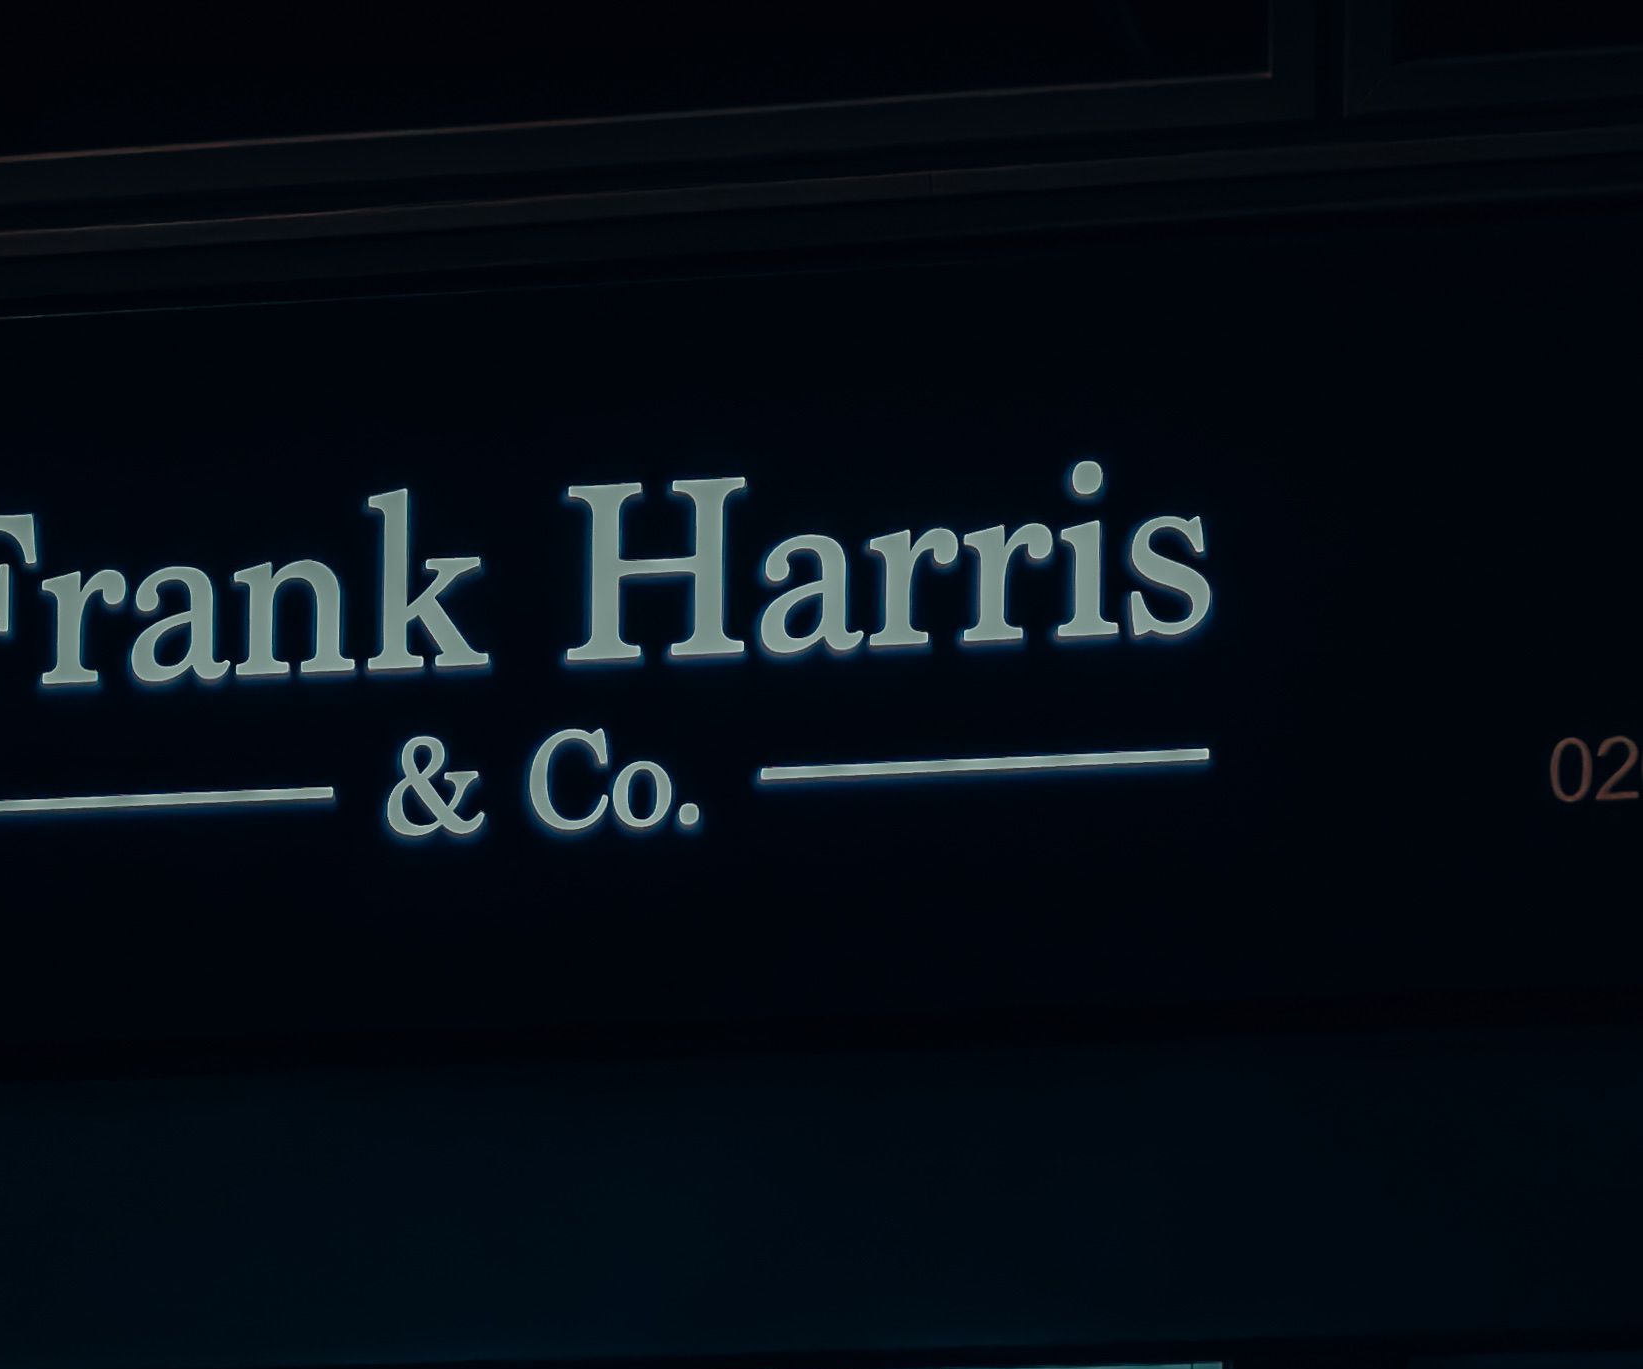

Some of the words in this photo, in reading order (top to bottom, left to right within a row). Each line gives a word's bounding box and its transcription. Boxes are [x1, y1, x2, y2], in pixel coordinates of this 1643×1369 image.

[565, 461, 1212, 663] Harris
[385, 735, 486, 838] &
[527, 726, 701, 832] Co.
[1549, 735, 1643, 803] 02
